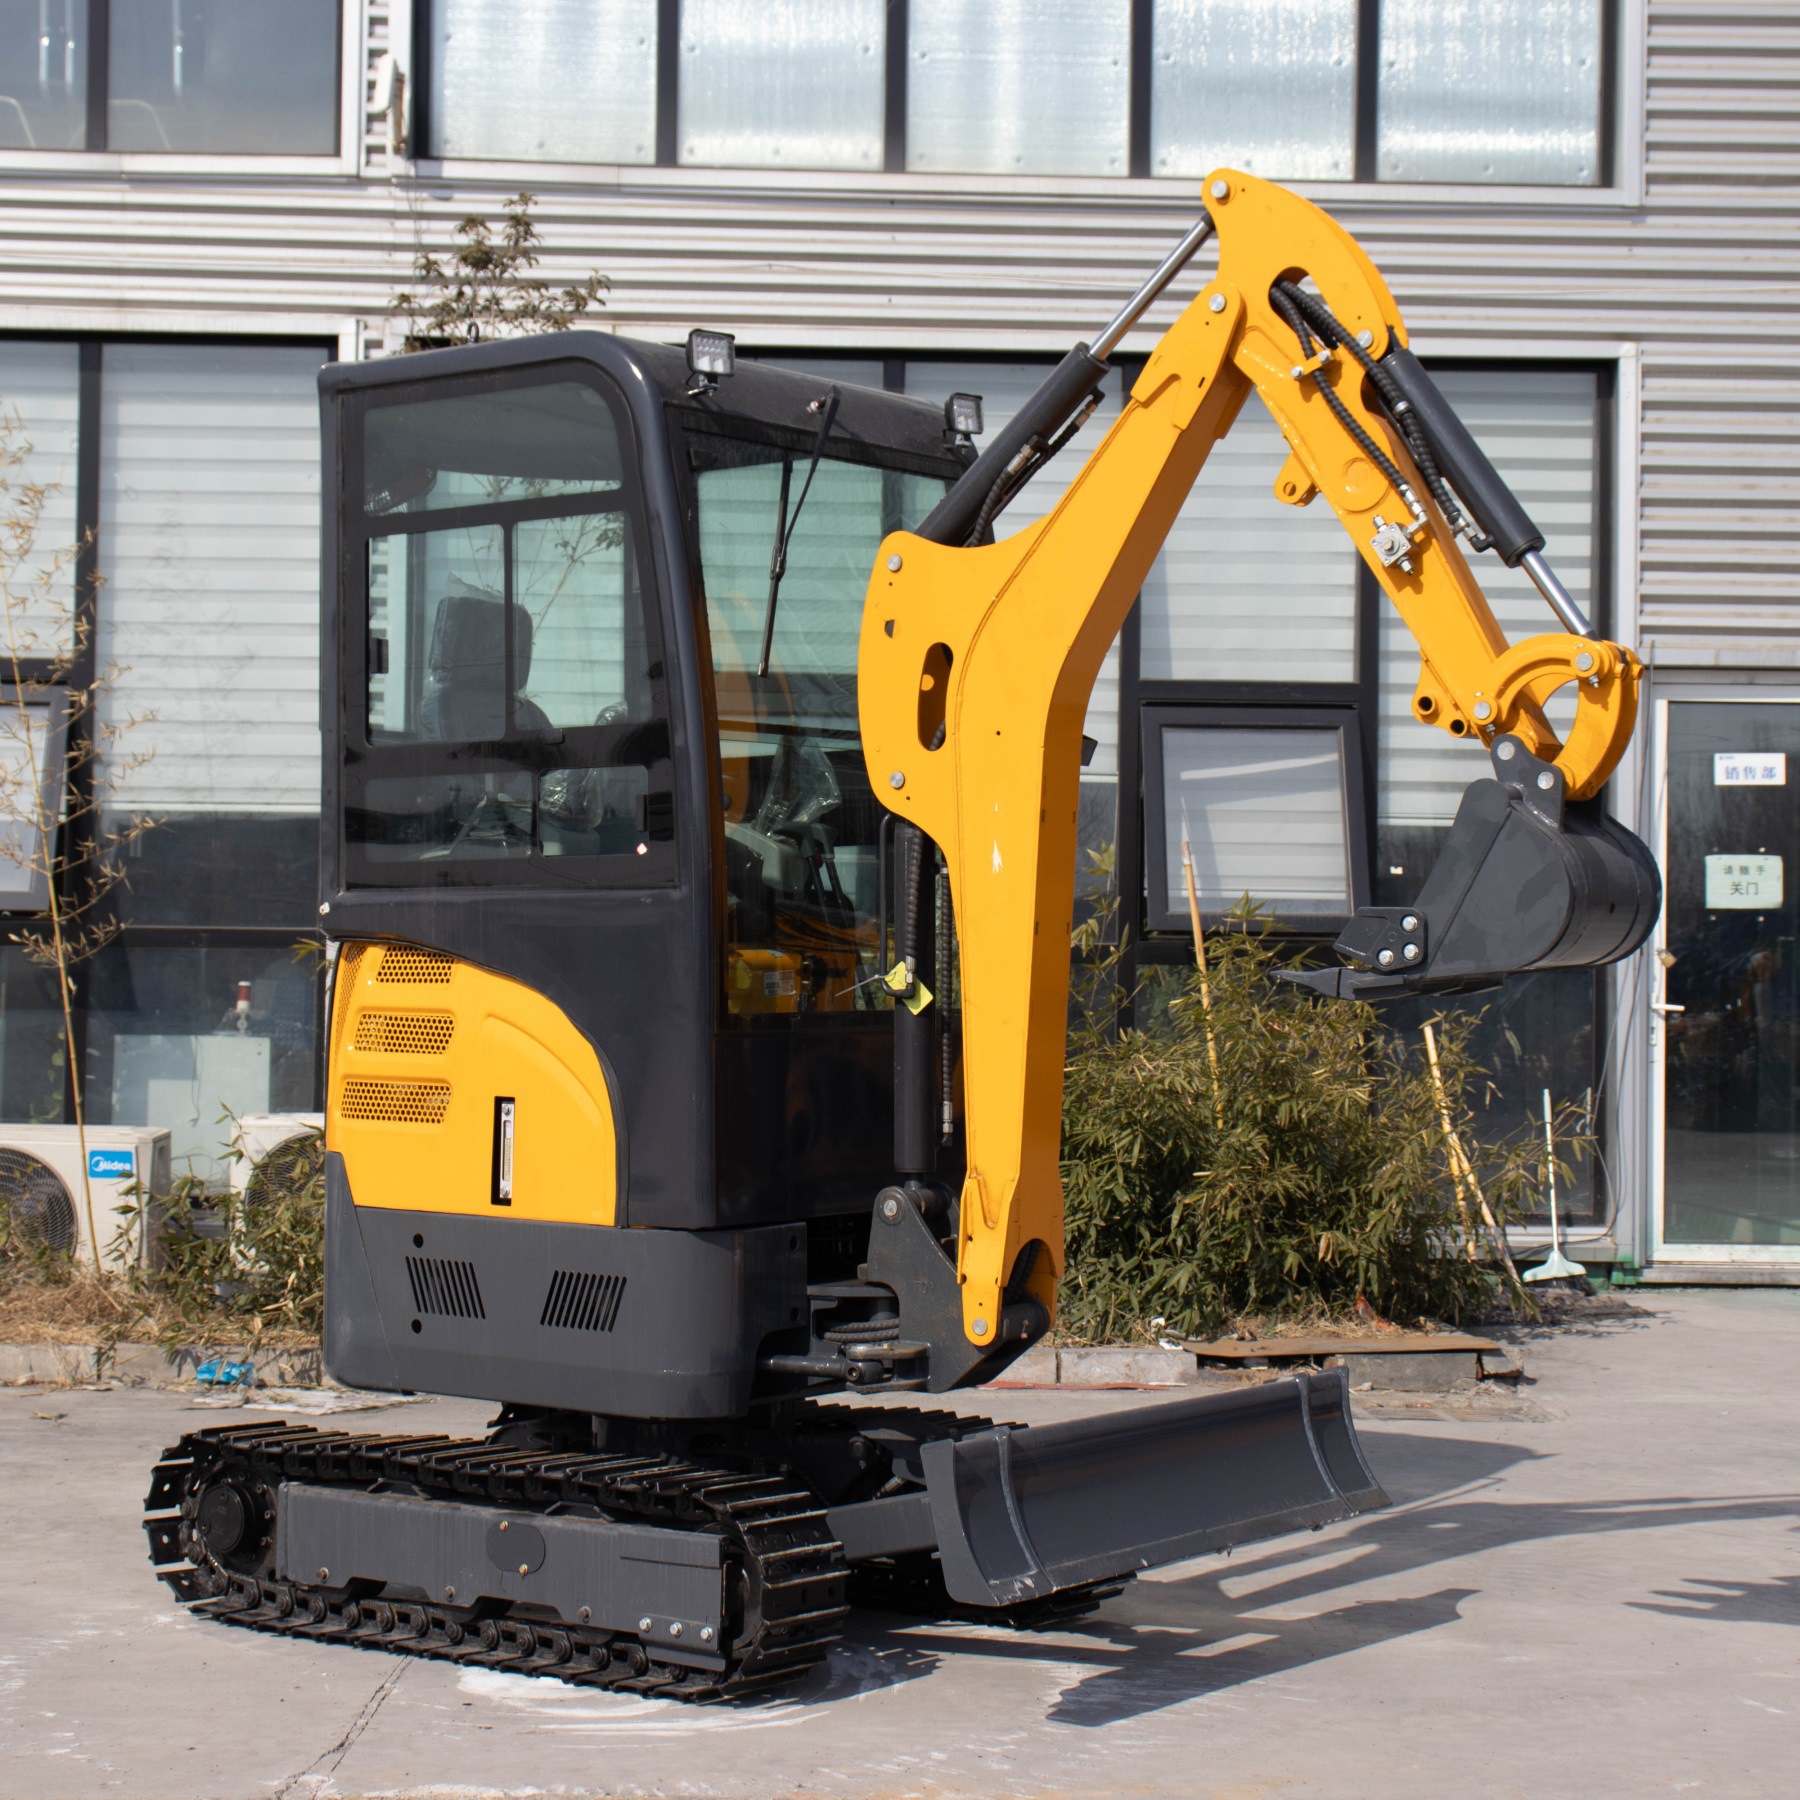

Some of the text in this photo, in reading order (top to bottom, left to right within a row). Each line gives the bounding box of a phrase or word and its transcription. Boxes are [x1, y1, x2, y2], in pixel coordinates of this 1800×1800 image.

[1725, 765, 1776, 780] 销售部
[1729, 881, 1759, 896] 关门
[98, 1159, 132, 1171] Midea
